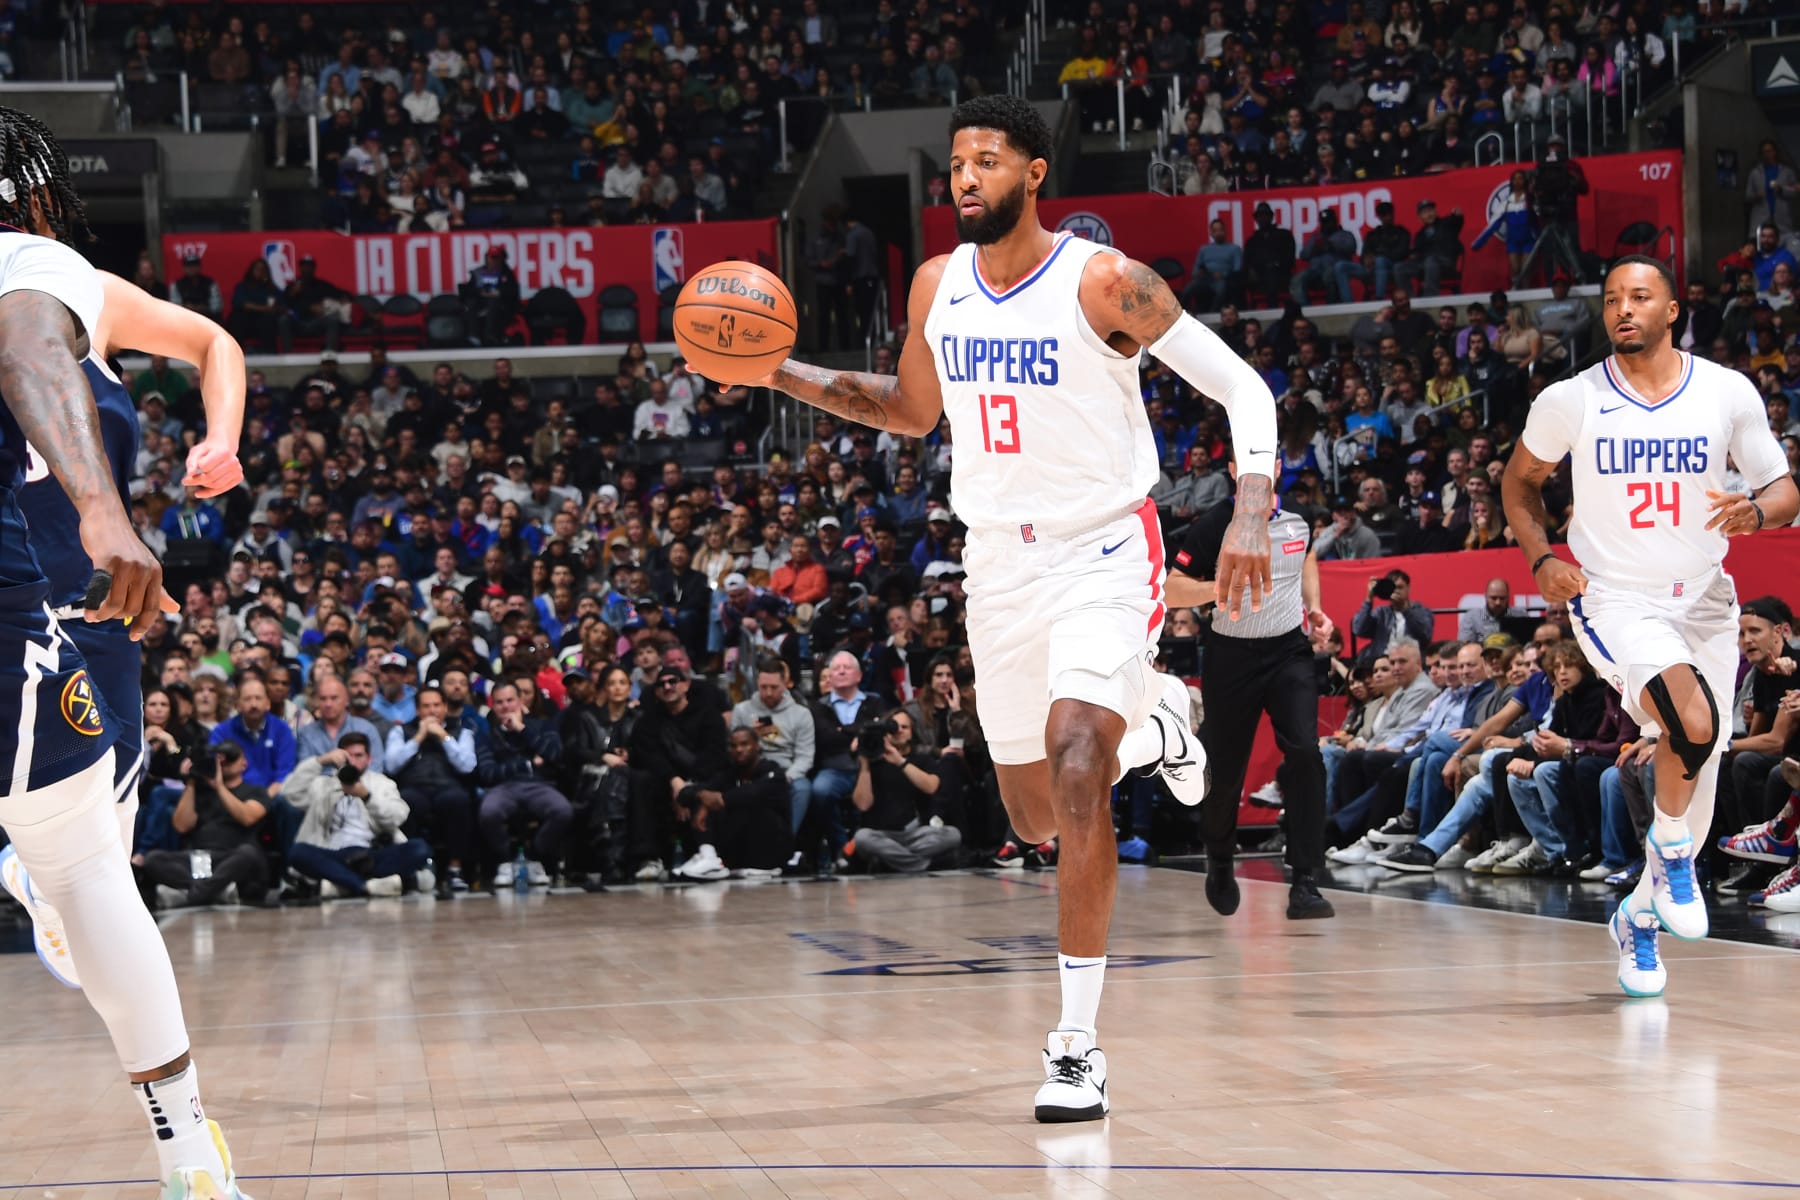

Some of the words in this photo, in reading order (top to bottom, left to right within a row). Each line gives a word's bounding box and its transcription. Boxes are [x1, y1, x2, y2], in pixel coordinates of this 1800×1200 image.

[1639, 161, 1672, 181] 107
[697, 277, 776, 311] Wilson
[941, 334, 1059, 386] CLIPPERS
[978, 394, 1021, 454] 13
[1595, 436, 1708, 475] CLIPPERS
[1626, 481, 1680, 529] 24
